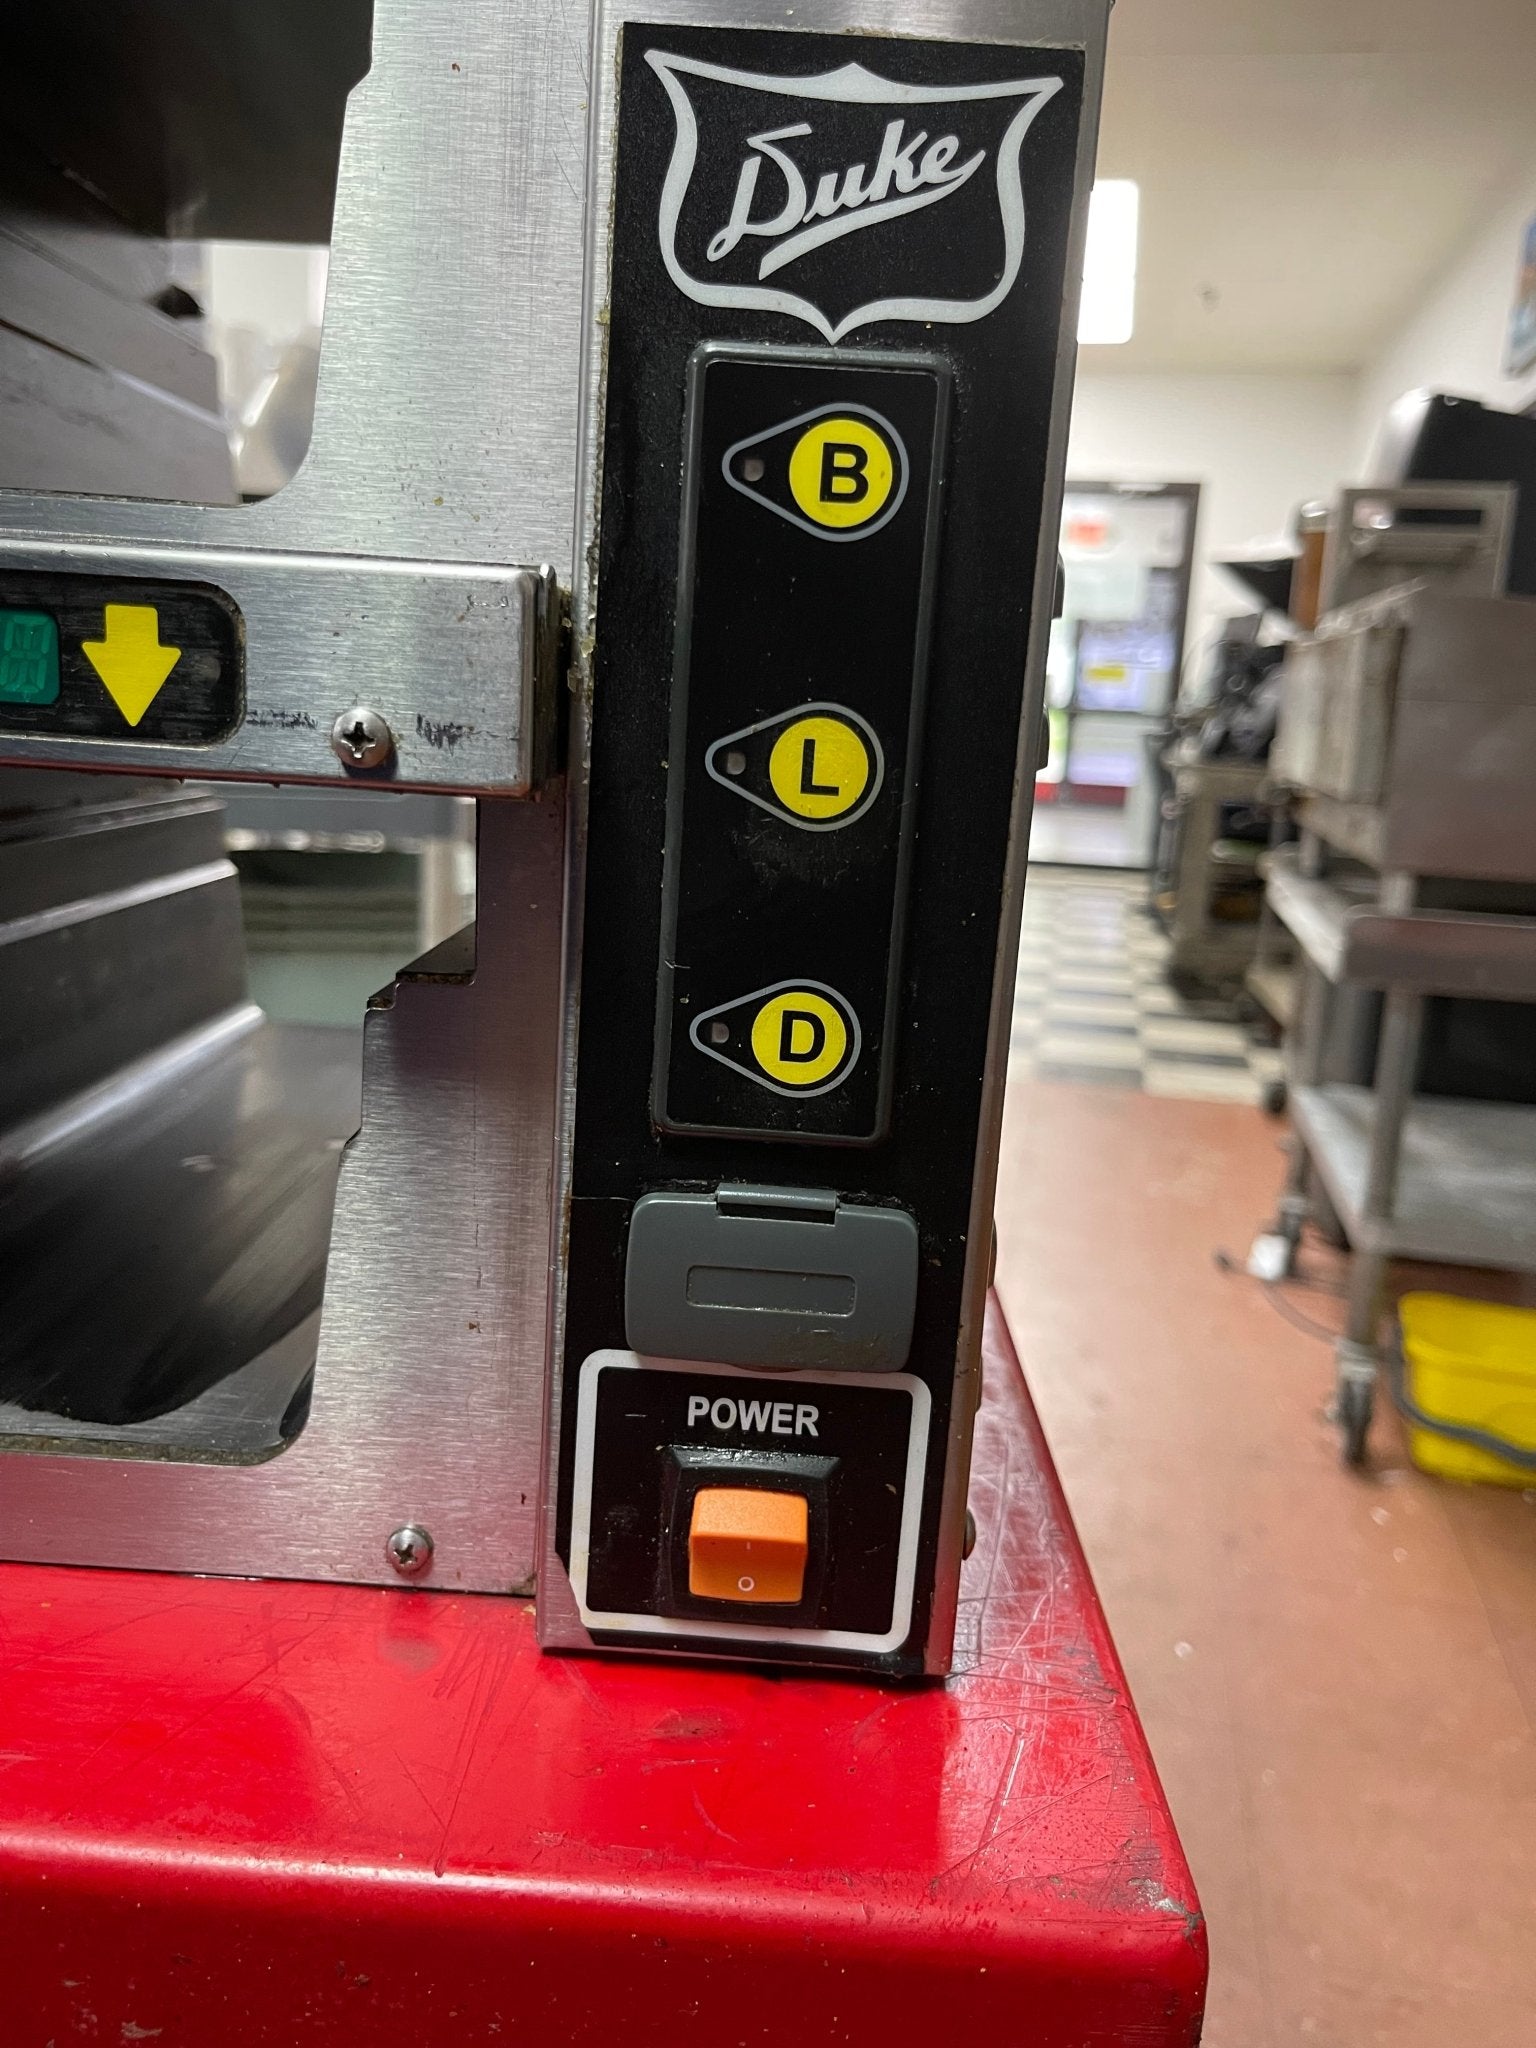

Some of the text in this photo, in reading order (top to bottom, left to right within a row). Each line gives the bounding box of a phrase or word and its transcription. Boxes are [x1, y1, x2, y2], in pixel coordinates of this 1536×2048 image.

[706, 119, 987, 281] Duke
[819, 442, 869, 504] B
[800, 738, 840, 797] L
[779, 1010, 826, 1063] D
[687, 1396, 819, 1437] POWER
